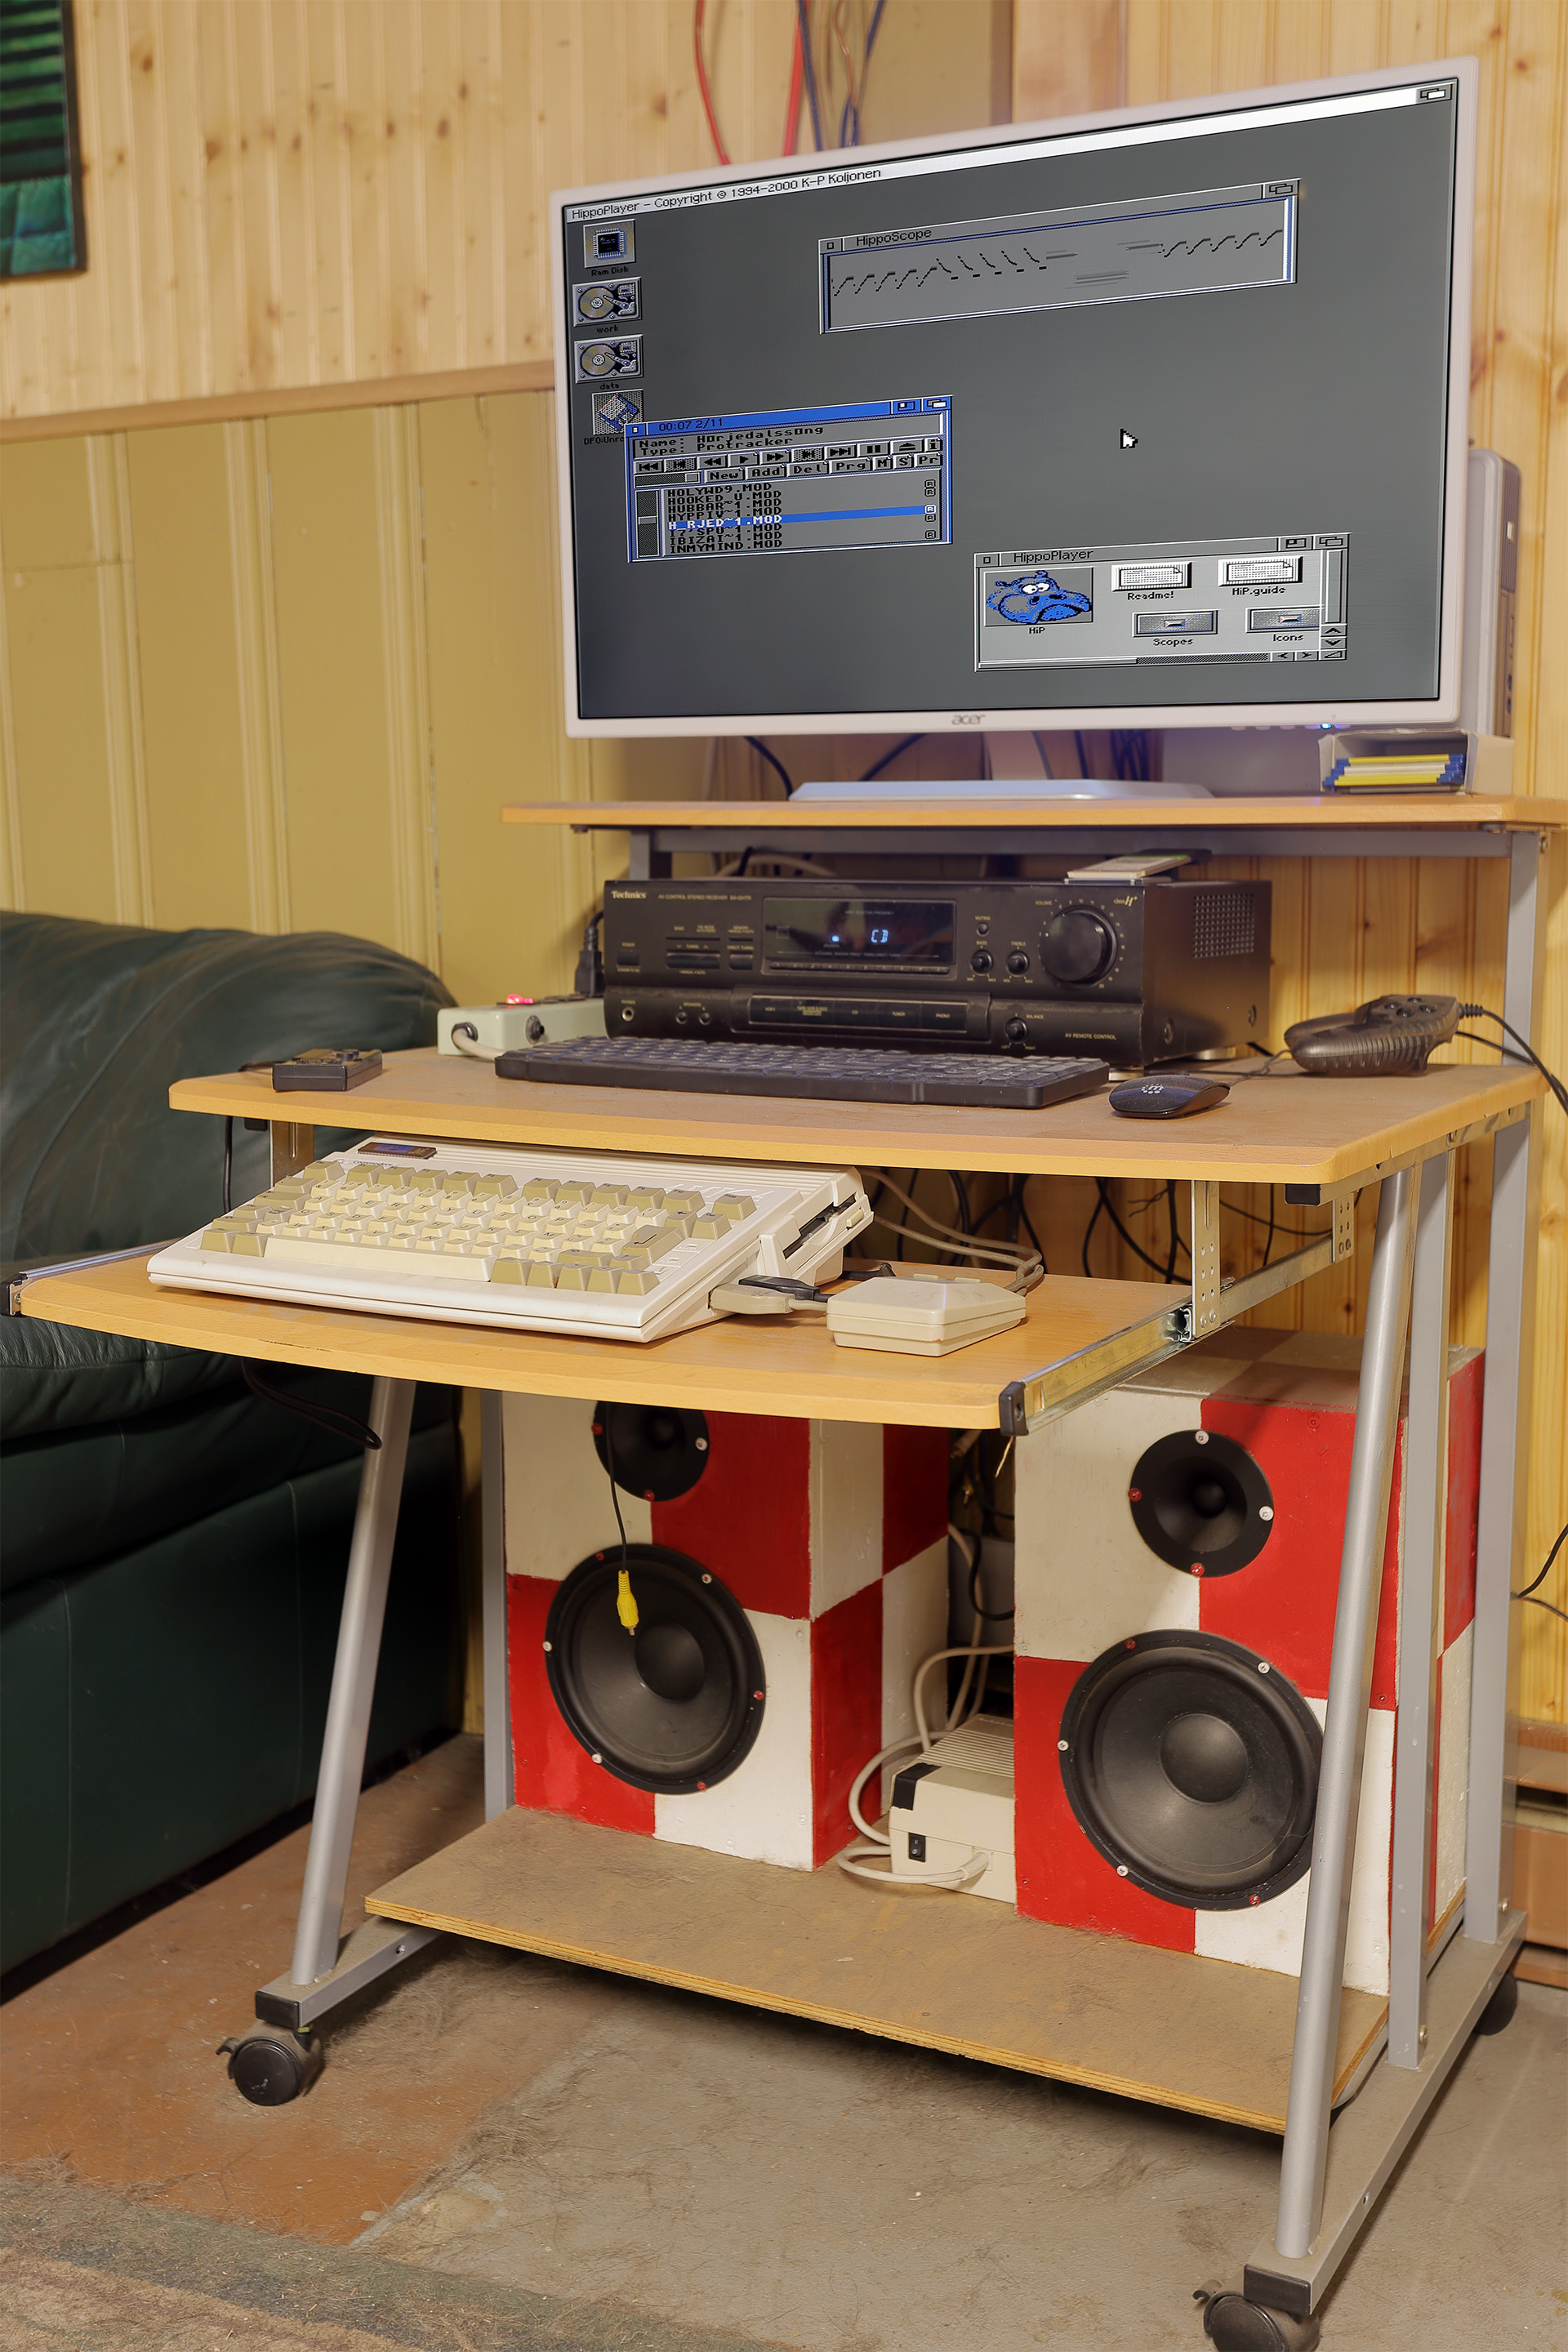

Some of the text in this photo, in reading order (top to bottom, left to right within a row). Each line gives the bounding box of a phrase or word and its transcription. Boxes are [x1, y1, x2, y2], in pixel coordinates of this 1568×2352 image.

[572, 203, 640, 220] HippoPlayer
[654, 191, 712, 208] Copyright
[732, 180, 798, 198] 1994-2000
[801, 176, 825, 188] K-P
[828, 169, 881, 185] Koljonen
[856, 229, 932, 247] HippoScope
[611, 266, 629, 274] Disk
[596, 324, 619, 333] work
[658, 418, 723, 431] 00:07 2/11
[639, 438, 684, 448] Name:
[640, 438, 793, 457] Type: Protracker
[710, 456, 938, 480] New Add Del Prg M S Pr
[670, 540, 782, 553] INMYMIND.MOD
[1013, 550, 1094, 563] HippoPlayer
[1127, 591, 1174, 600] Readme!
[1232, 587, 1286, 597] HiP.guide
[1028, 626, 1045, 635] HiP
[1153, 638, 1193, 647] Scopes
[1273, 634, 1304, 642] Icons
[951, 713, 987, 725] acer
[611, 890, 647, 899] Technics
